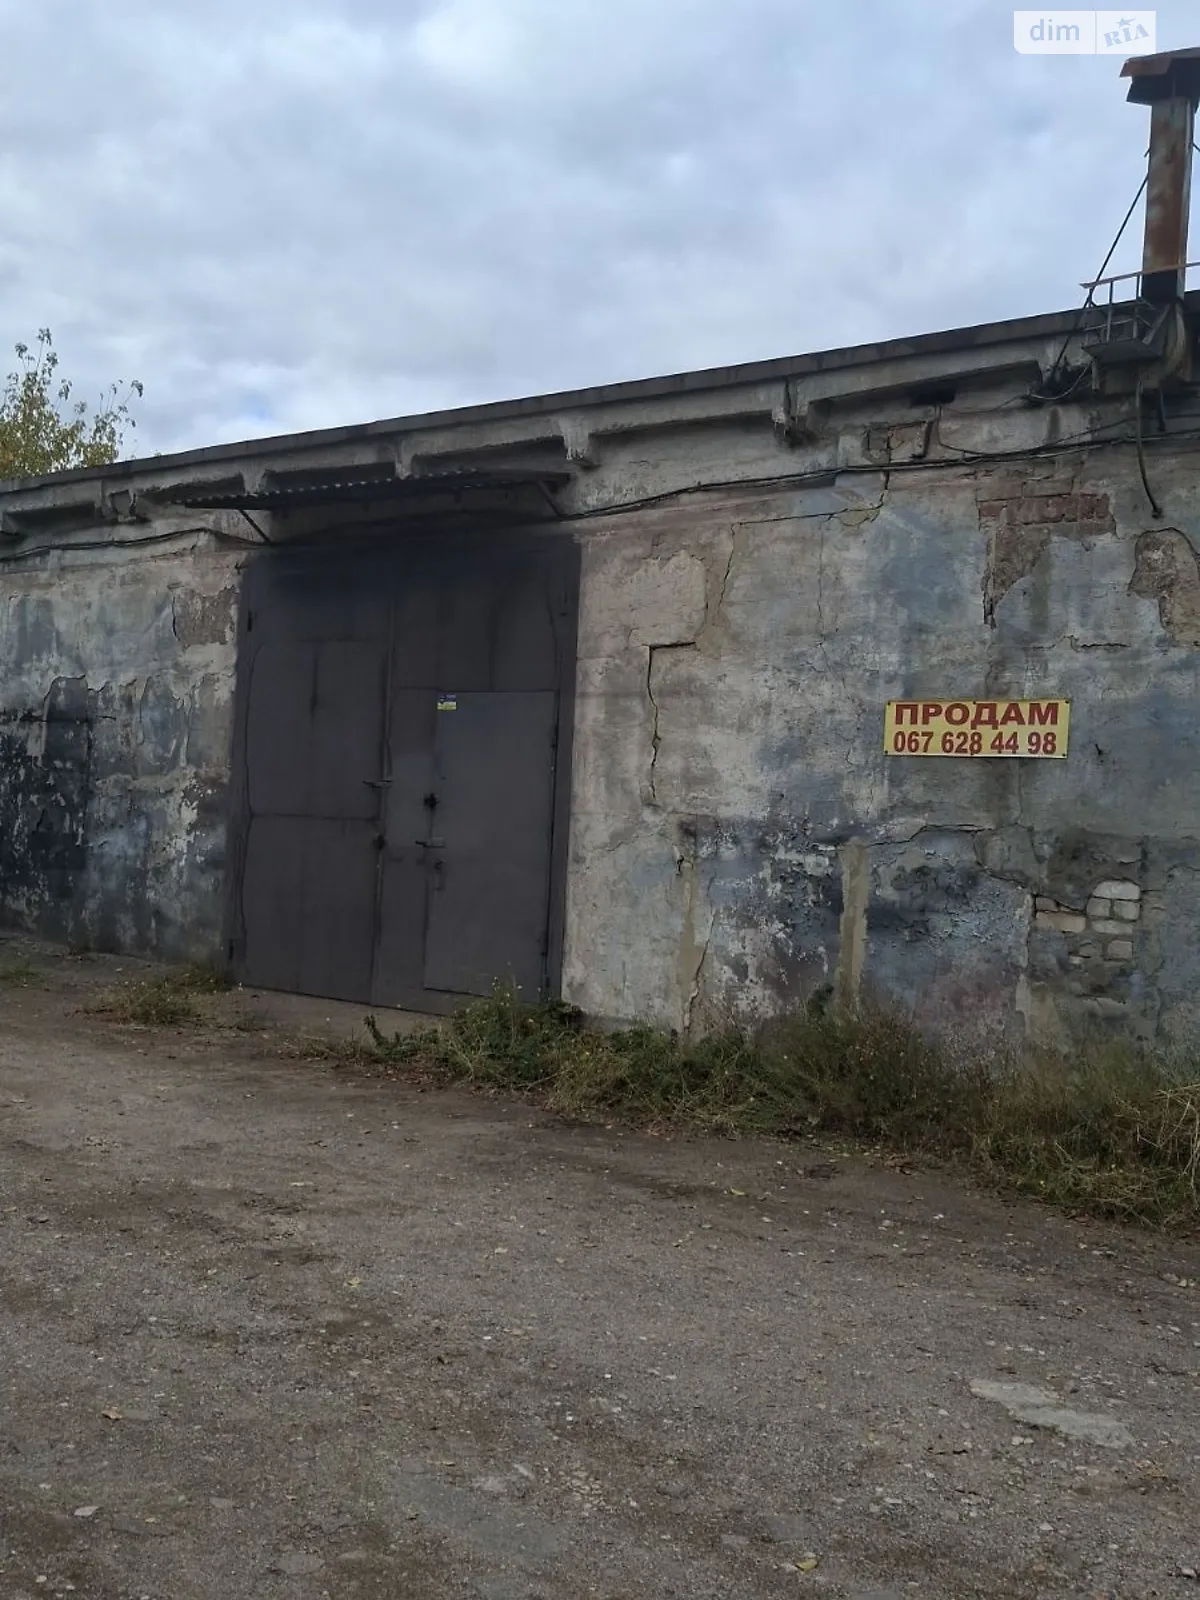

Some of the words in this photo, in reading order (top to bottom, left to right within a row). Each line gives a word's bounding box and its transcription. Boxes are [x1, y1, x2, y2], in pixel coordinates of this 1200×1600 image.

[894, 702, 1060, 730] ПРОДАМ
[893, 731, 934, 753] 067
[941, 732, 983, 755] 628
[990, 731, 1020, 754] 44
[1027, 732, 1057, 755] 98
